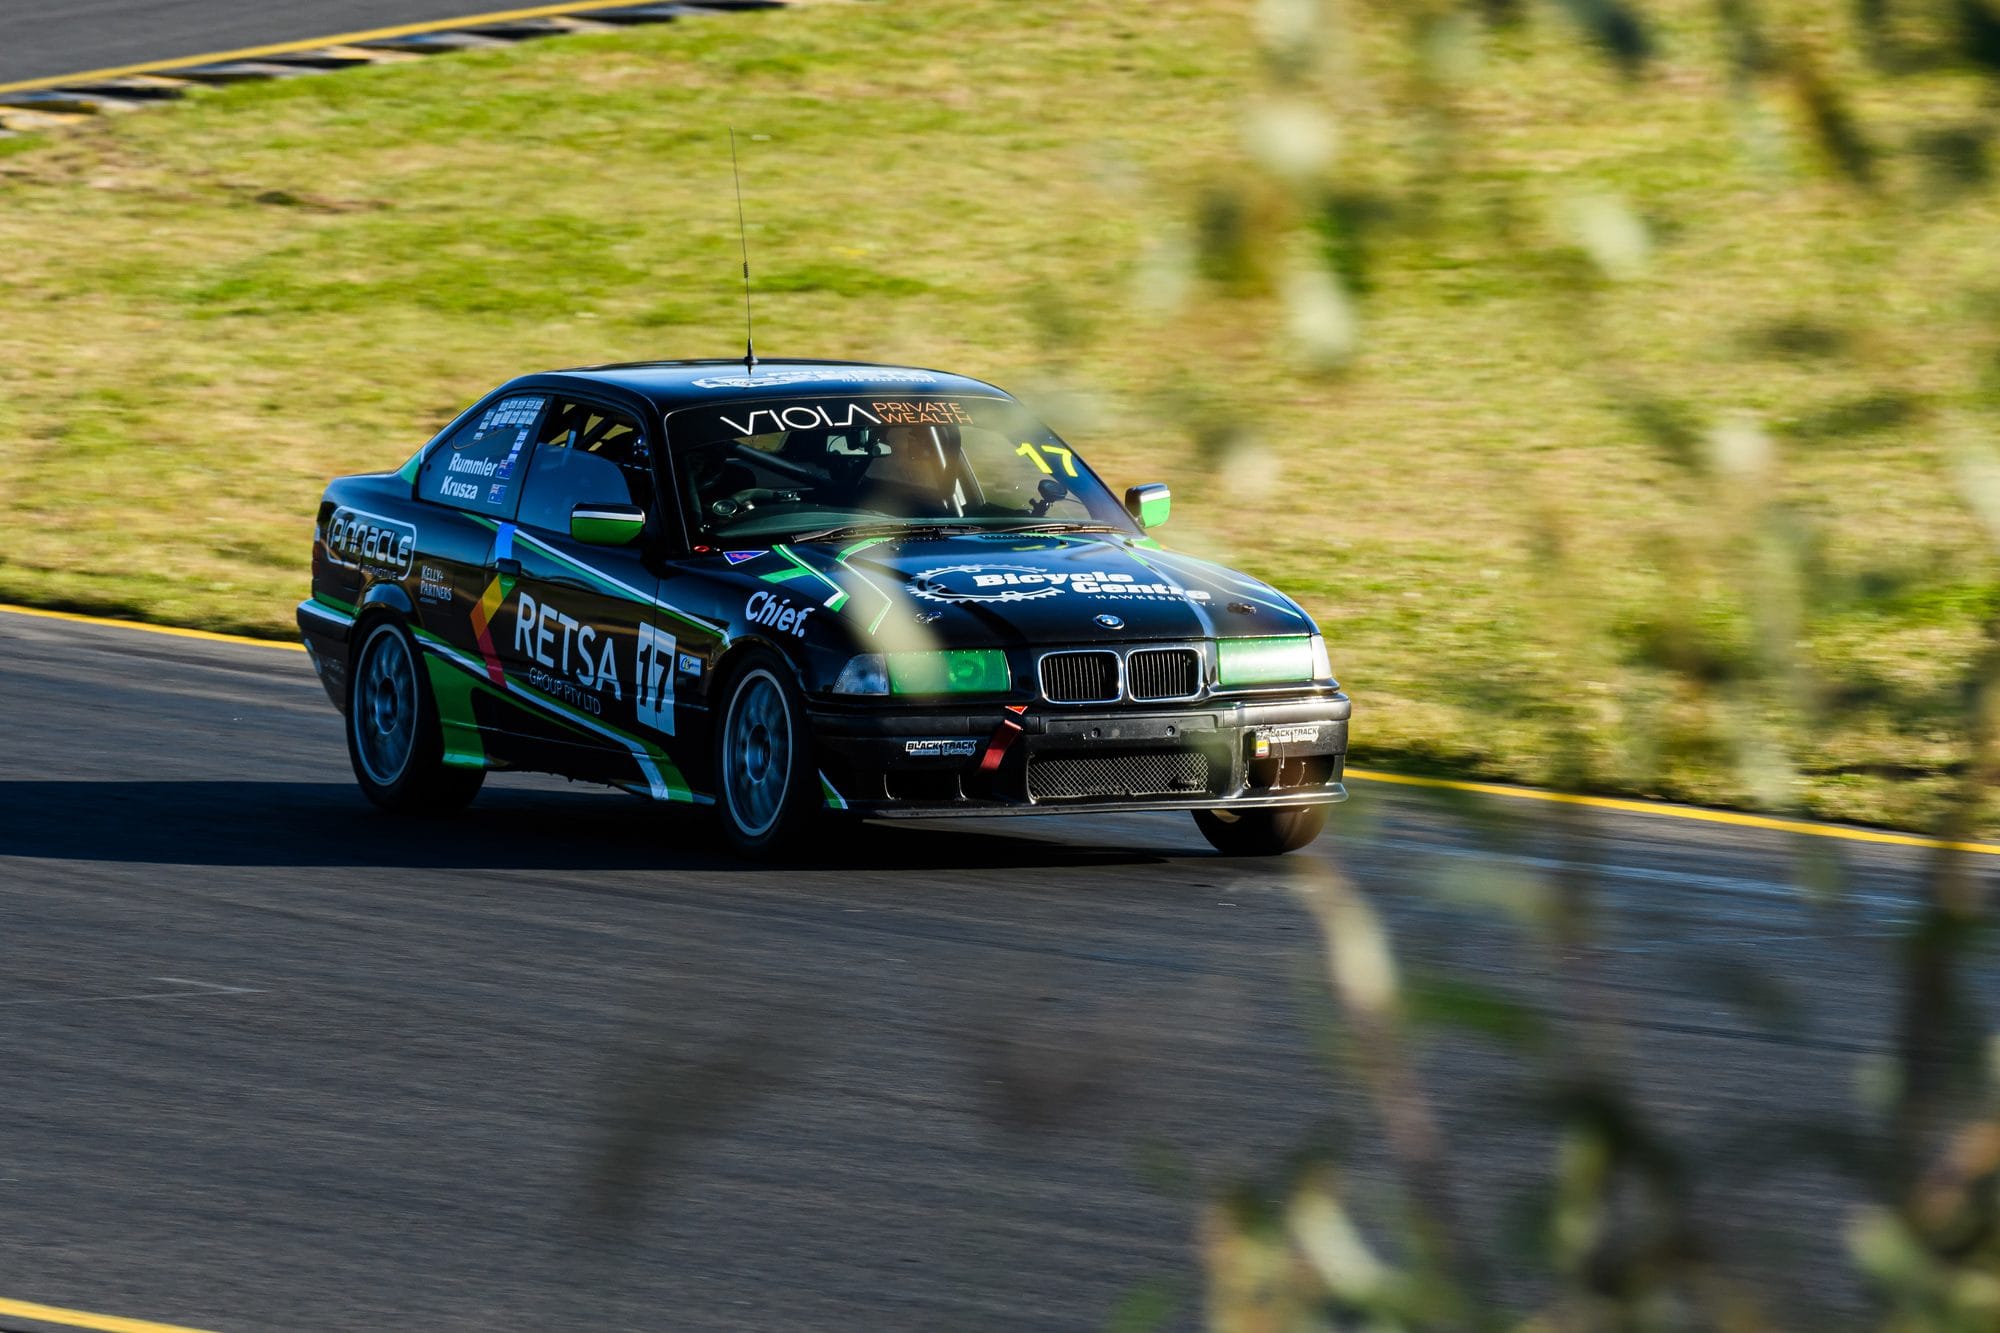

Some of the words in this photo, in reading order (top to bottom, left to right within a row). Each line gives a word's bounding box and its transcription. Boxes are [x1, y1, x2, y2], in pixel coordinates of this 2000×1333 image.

[720, 403, 882, 435] VIOLA
[872, 402, 966, 414] PRIVATE
[879, 412, 973, 425] WEALTH
[448, 453, 498, 477] Rummler
[1015, 442, 1078, 477] 17
[440, 475, 478, 500] Krusza
[420, 580, 452, 601] PARTNERS
[973, 571, 1134, 587] Bicycle
[1071, 581, 1211, 600] Centre
[515, 591, 622, 700] RETSA
[638, 643, 673, 713] 17
[529, 667, 562, 697] GROUP
[564, 684, 582, 706] PTY
[583, 693, 601, 715] LTD
[1293, 727, 1318, 736] TRACK
[906, 741, 940, 751] BLACK
[942, 741, 976, 751] TRACK
